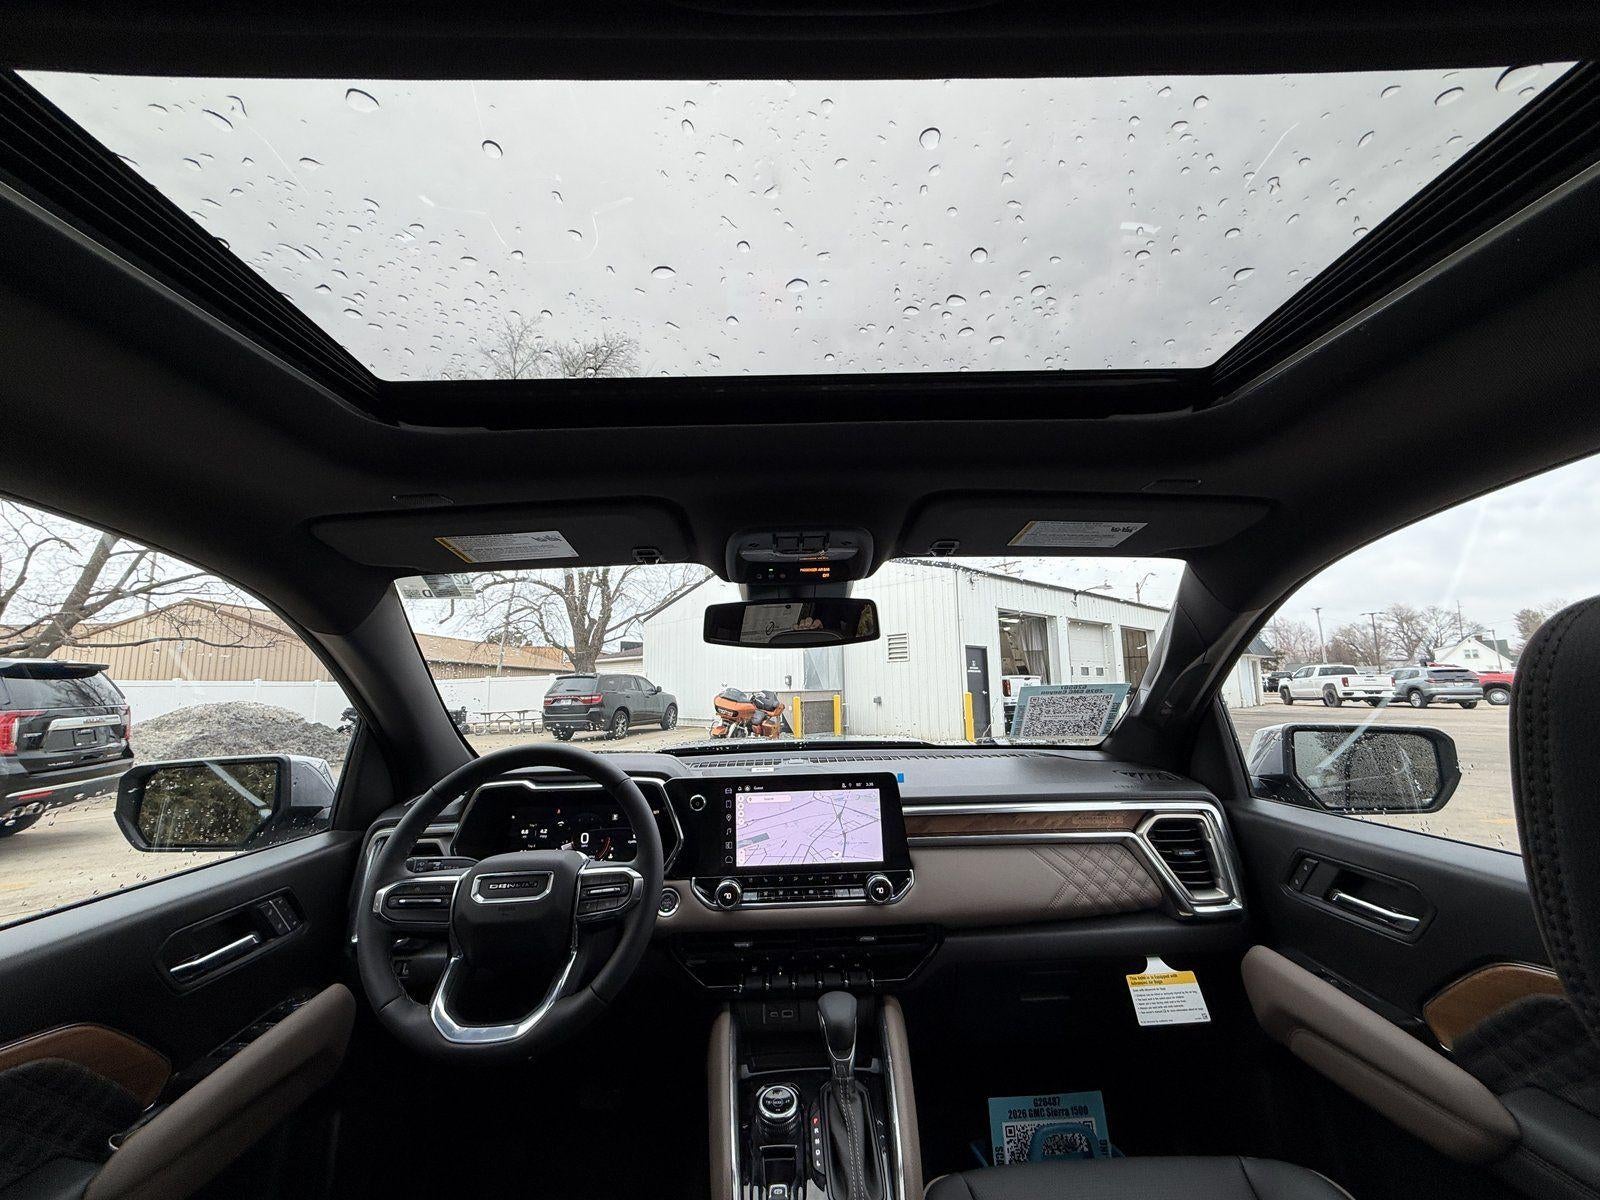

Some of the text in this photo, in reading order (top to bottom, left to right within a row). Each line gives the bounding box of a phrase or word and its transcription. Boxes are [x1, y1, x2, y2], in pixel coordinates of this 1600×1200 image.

[580, 833, 589, 844] 0
[1008, 1105, 1089, 1120] 2026 GMC Sierra 1500
